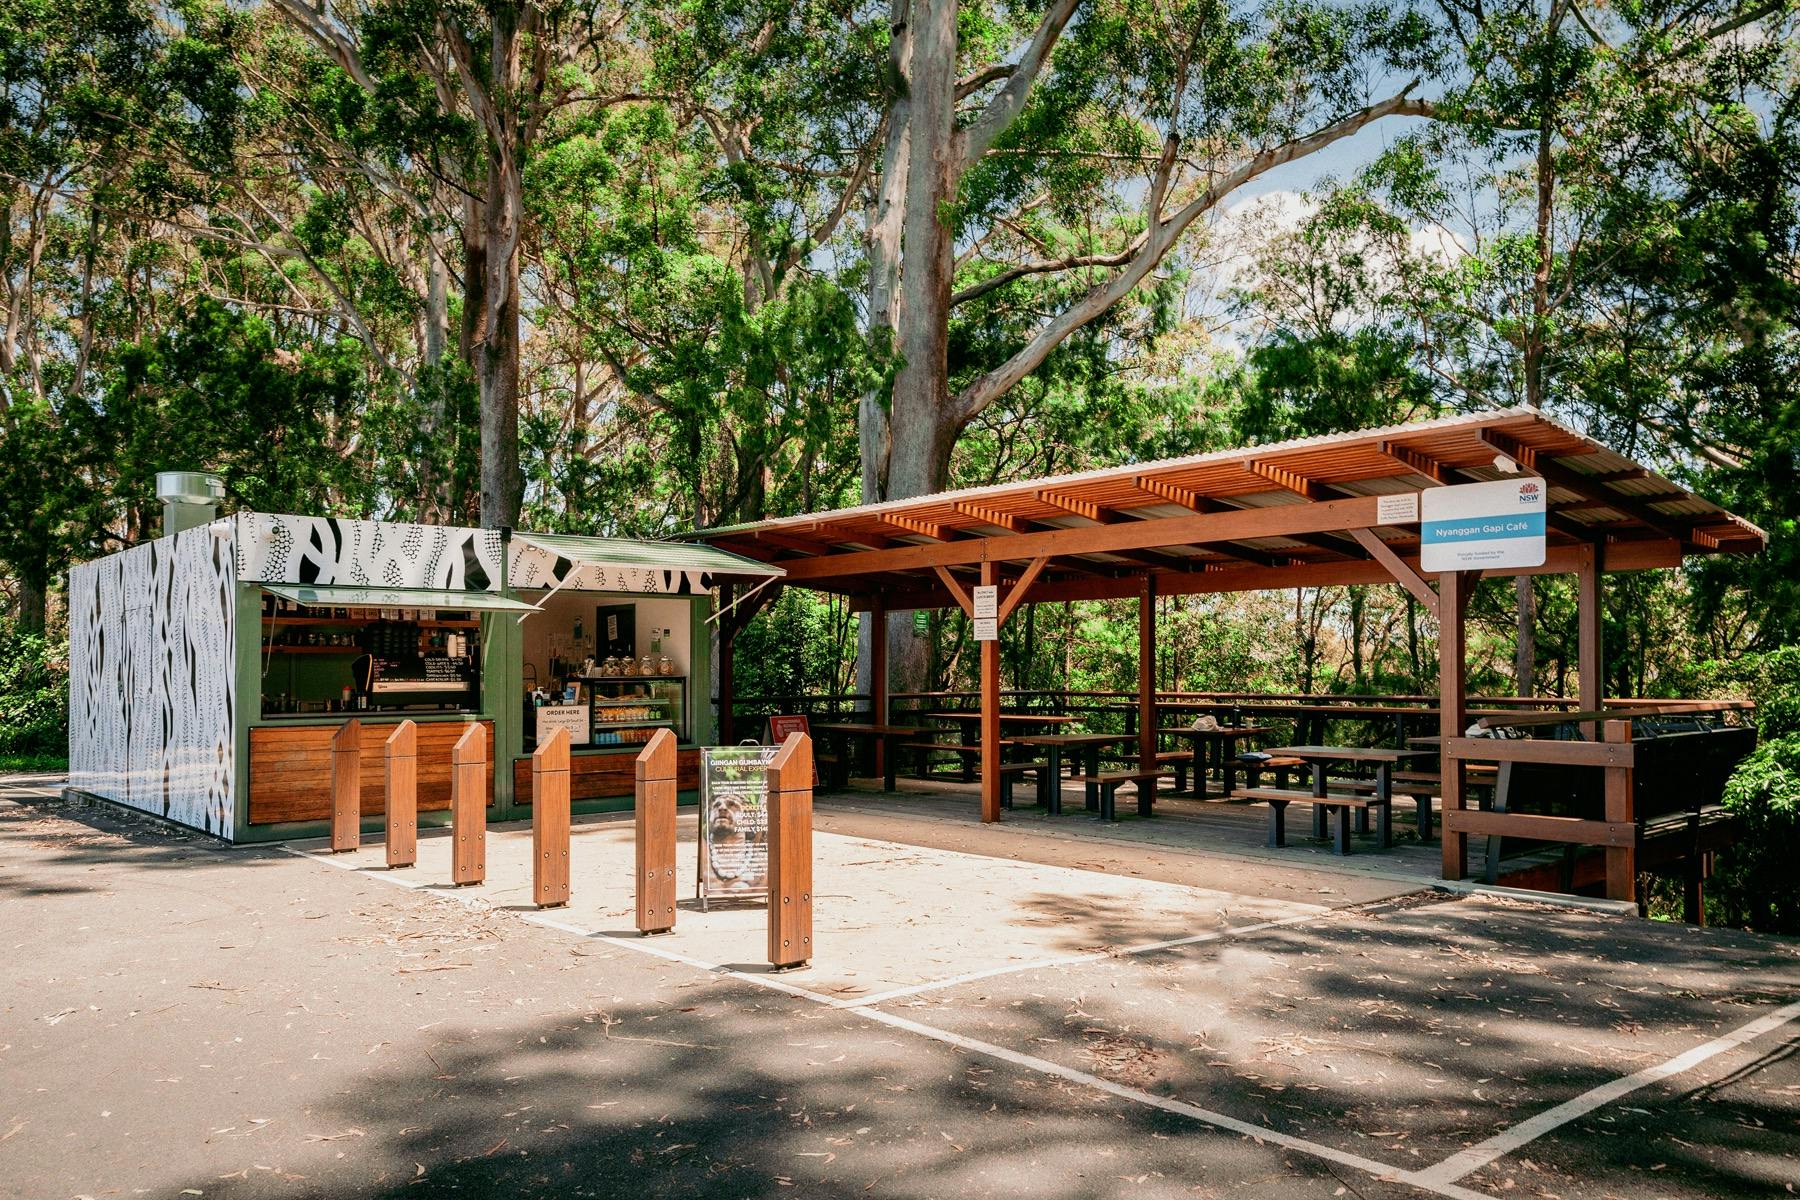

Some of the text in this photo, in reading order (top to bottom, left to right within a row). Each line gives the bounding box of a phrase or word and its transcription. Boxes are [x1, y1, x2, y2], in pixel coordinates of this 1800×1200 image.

[1436, 521, 1528, 537] Nyanggan Gapi Café
